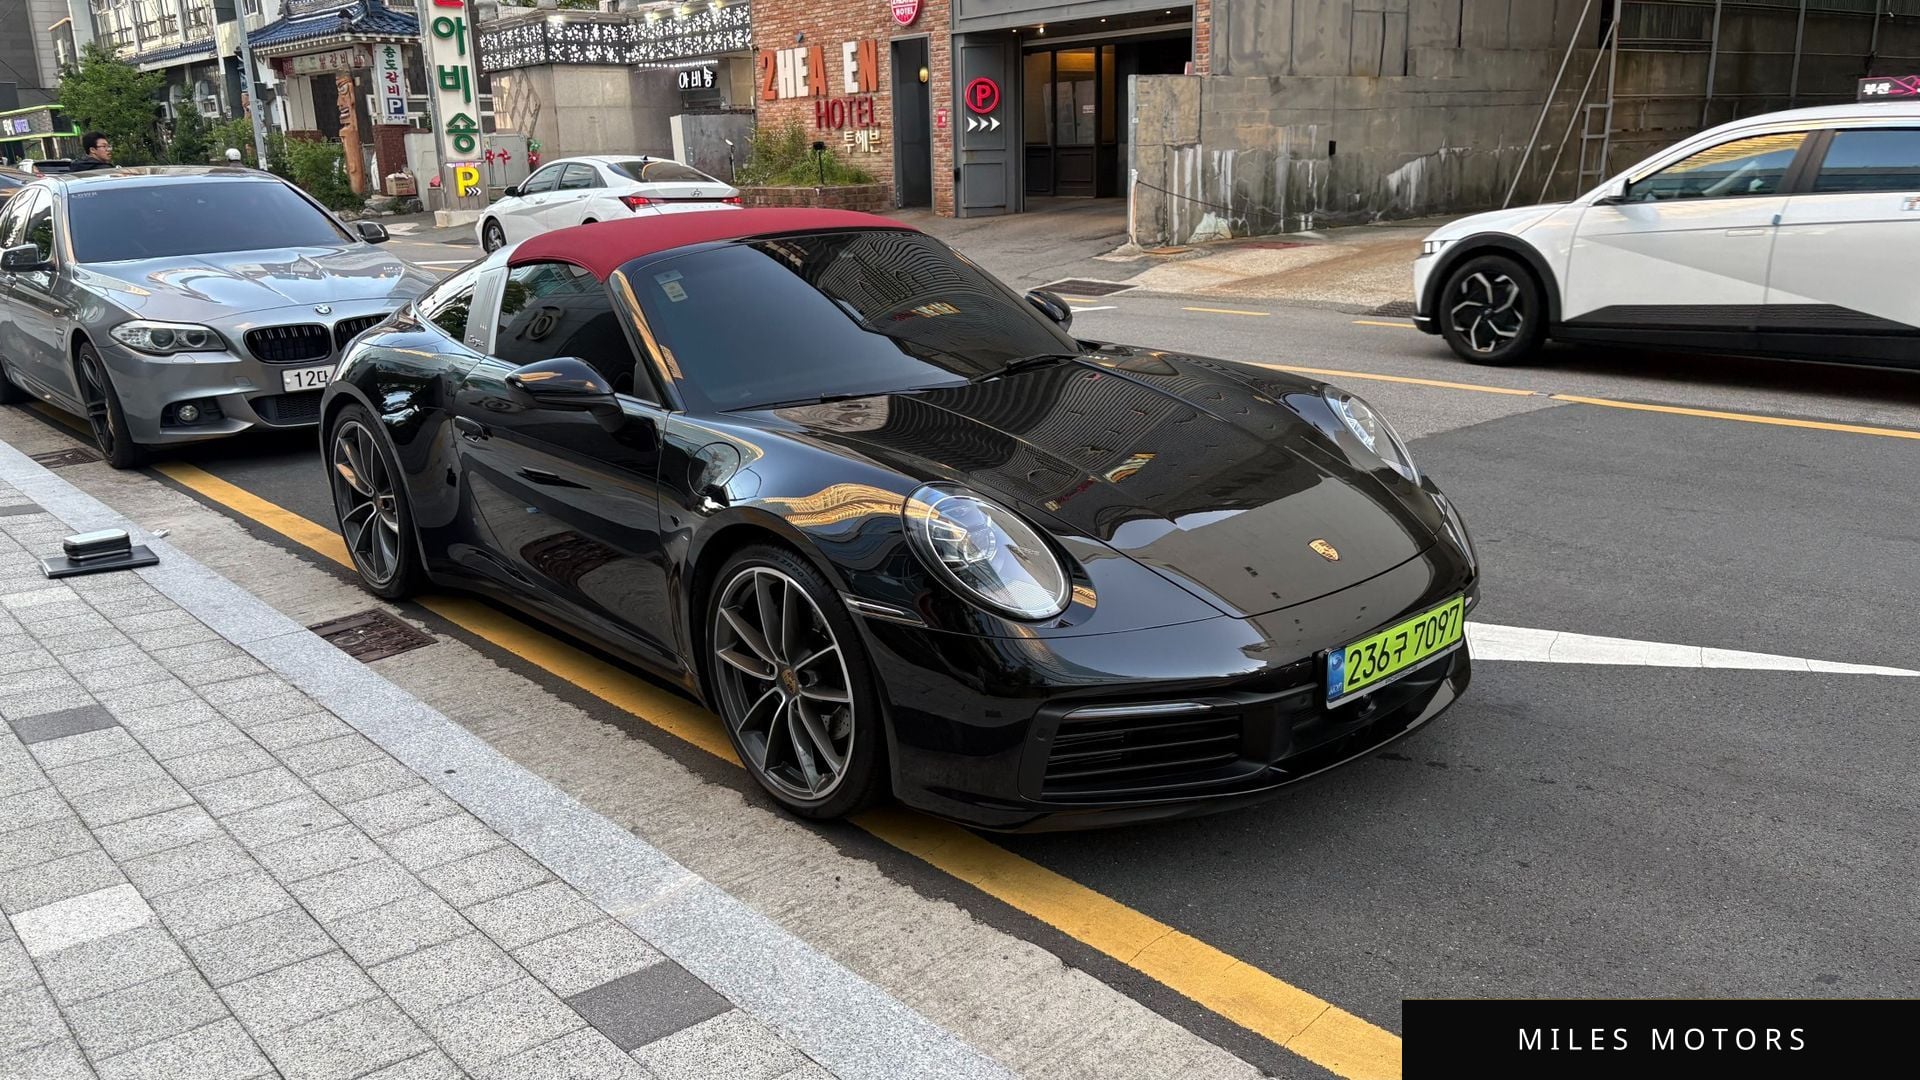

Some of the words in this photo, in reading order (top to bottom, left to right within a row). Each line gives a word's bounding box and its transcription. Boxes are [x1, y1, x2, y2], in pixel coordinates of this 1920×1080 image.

[432, 0, 479, 153] 아비송
[679, 66, 713, 88] 아비송
[1863, 82, 1891, 95] 부산
[388, 98, 402, 114] P
[976, 85, 991, 107] P
[815, 95, 881, 129] HOTEL
[843, 129, 882, 154] 투헤븐
[455, 165, 480, 197] P
[1347, 631, 1408, 687] 236구
[1414, 603, 1460, 656] 7097
